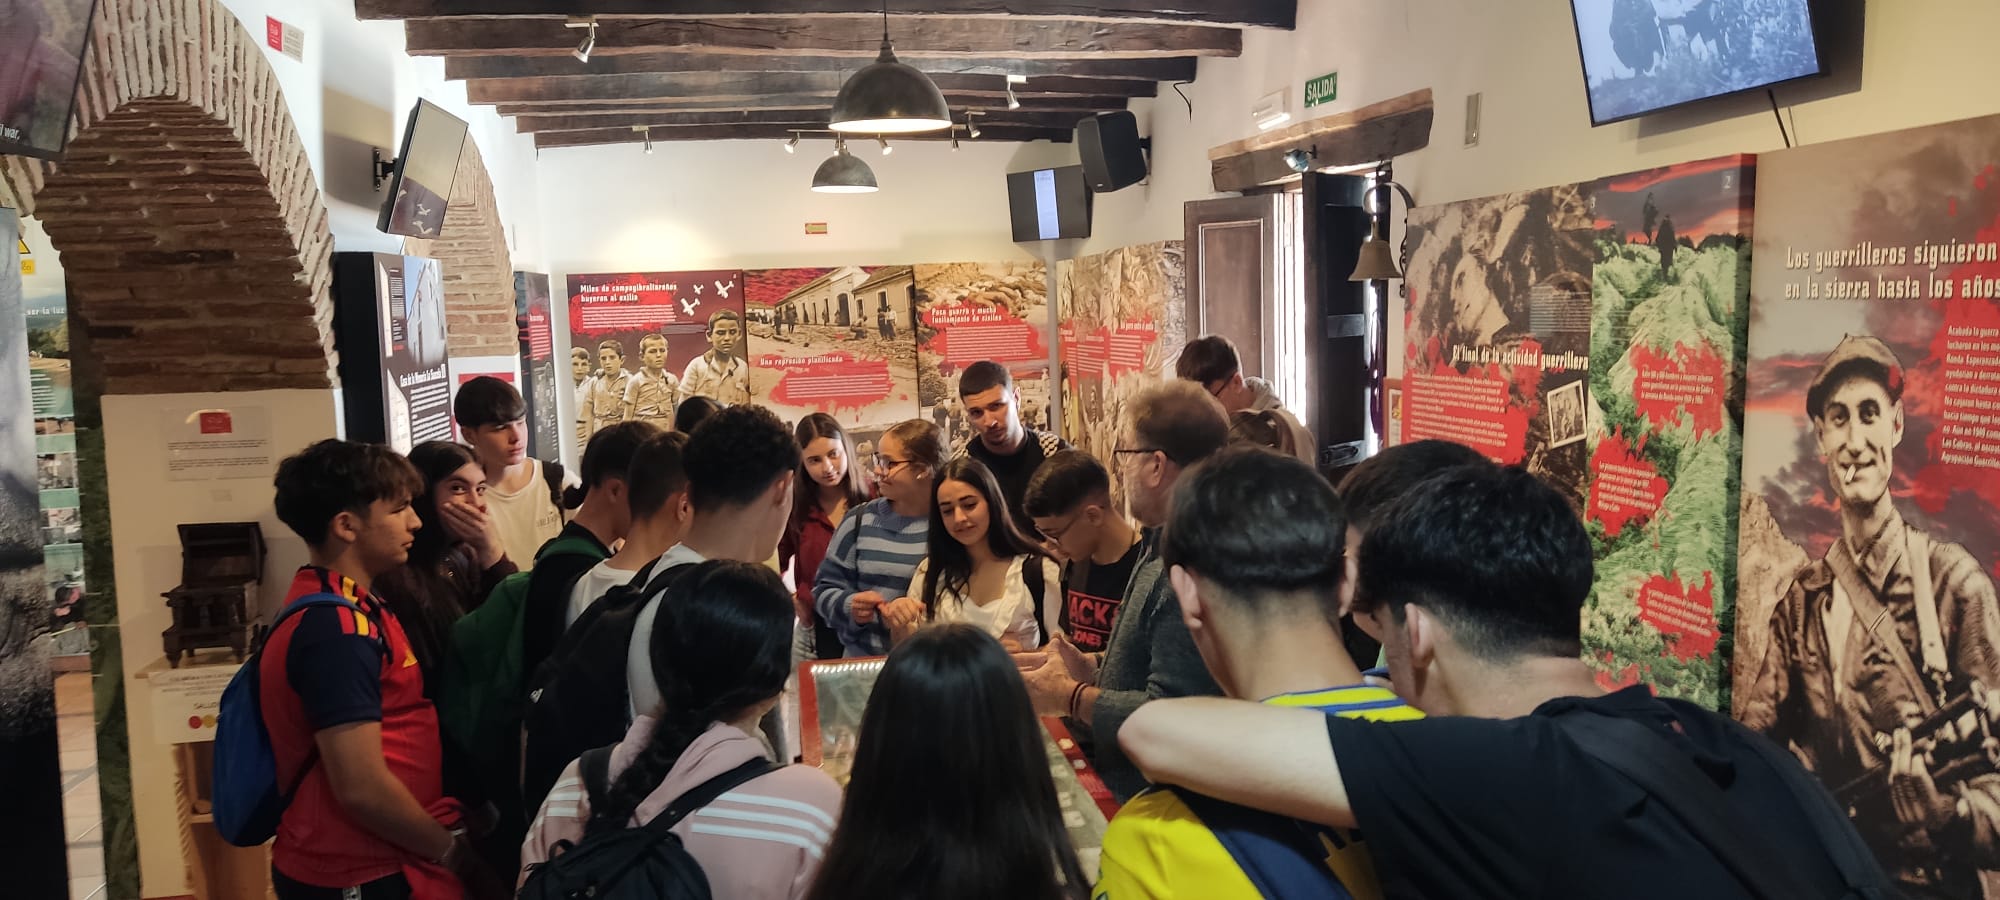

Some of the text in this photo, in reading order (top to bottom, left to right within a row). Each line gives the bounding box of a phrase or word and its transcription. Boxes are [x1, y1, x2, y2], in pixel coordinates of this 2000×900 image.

[1307, 77, 1334, 101] SALIDA
[1786, 238, 1997, 273] Los guerrilleros siguieron
[580, 284, 599, 293] Miles
[601, 284, 610, 292] de
[619, 294, 639, 302] exilio
[1785, 272, 2000, 299] en la sierra hasta los años
[948, 308, 969, 316] guerra
[1453, 345, 1589, 371] El final de la actividad guerrillera
[1069, 596, 1111, 625] ACK
